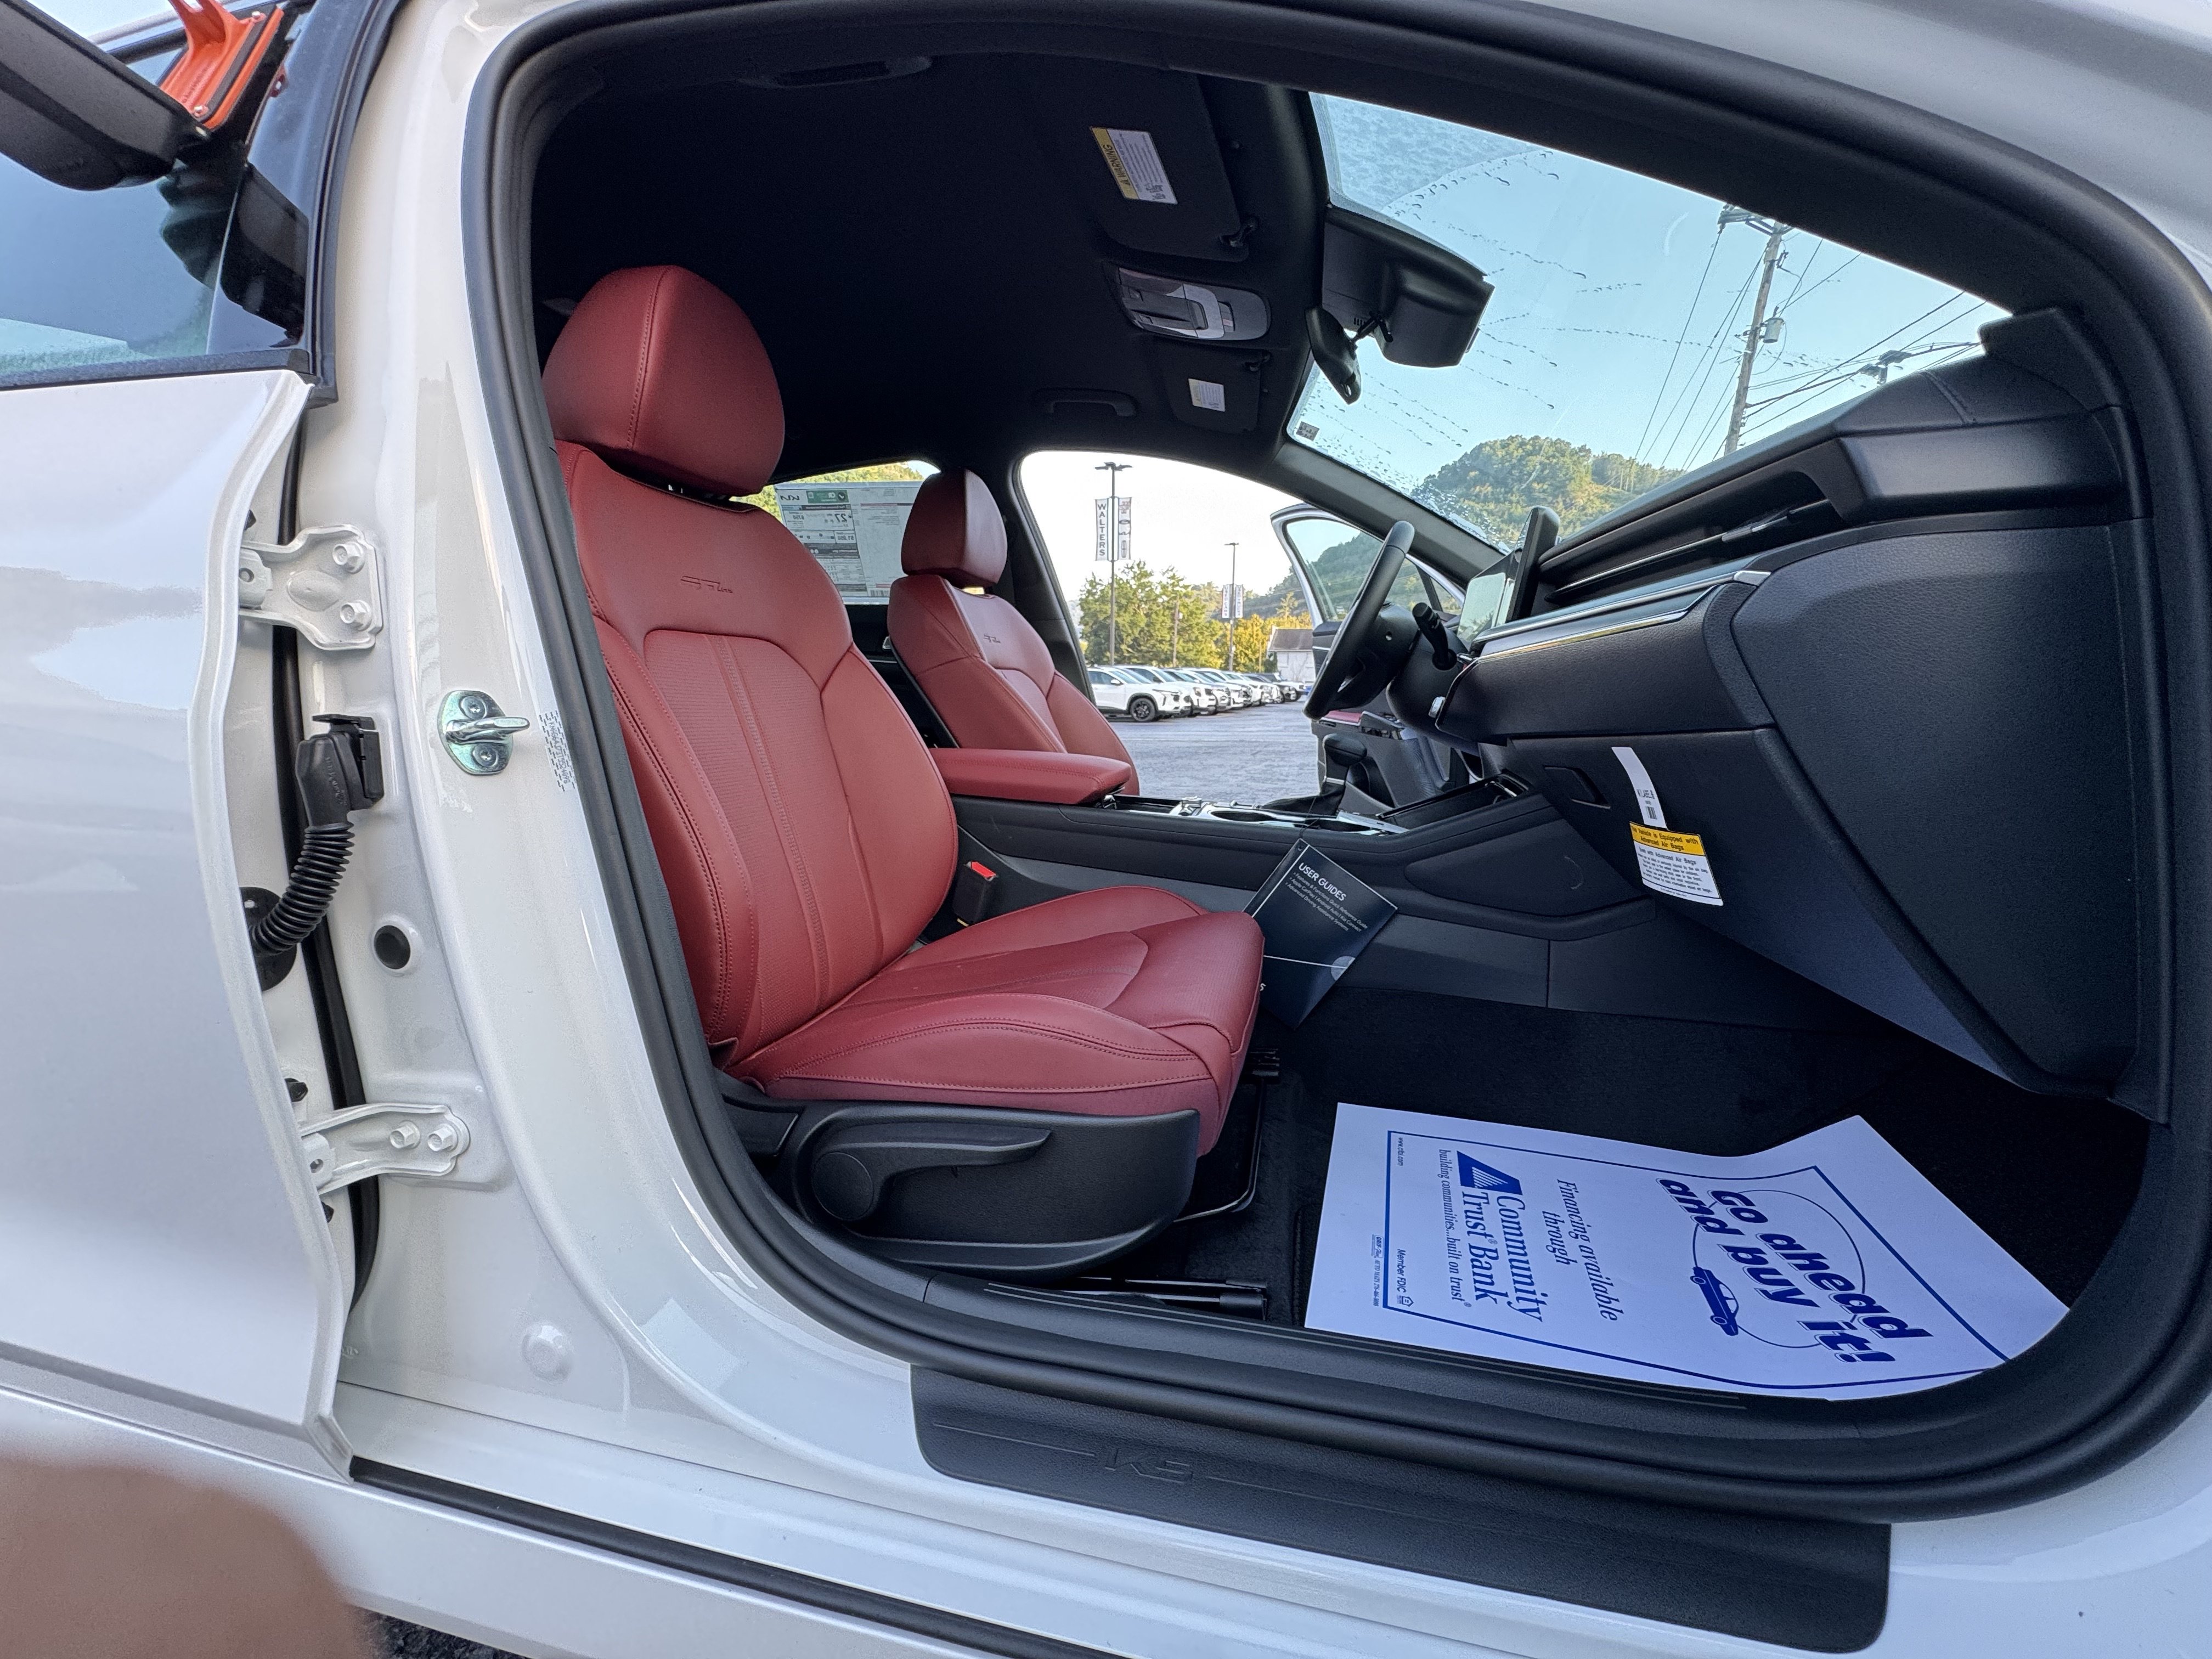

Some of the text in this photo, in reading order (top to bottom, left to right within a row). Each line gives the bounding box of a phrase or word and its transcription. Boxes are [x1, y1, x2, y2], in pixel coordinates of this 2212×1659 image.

[1103, 144, 1126, 178] WARNING
[1098, 503, 1106, 556] WALTERS
[1684, 836, 1699, 845] with
[1286, 883, 1305, 898] Advanced
[1298, 862, 1347, 901] USER GUIDES
[1437, 1149, 1453, 1180] building
[1448, 1261, 1460, 1274] on
[1542, 1210, 1578, 1266] through
[1397, 1249, 1407, 1279] Member
[1468, 1243, 1509, 1305] Bank
[1496, 1195, 1549, 1323] Community
[1556, 1178, 1624, 1322] Financing available
[1656, 1177, 1896, 1363] and buy it!
[1397, 1278, 1407, 1293] FDIC
[1756, 1233, 1933, 1339] ahead
[1104, 1448, 1193, 1483] K5
